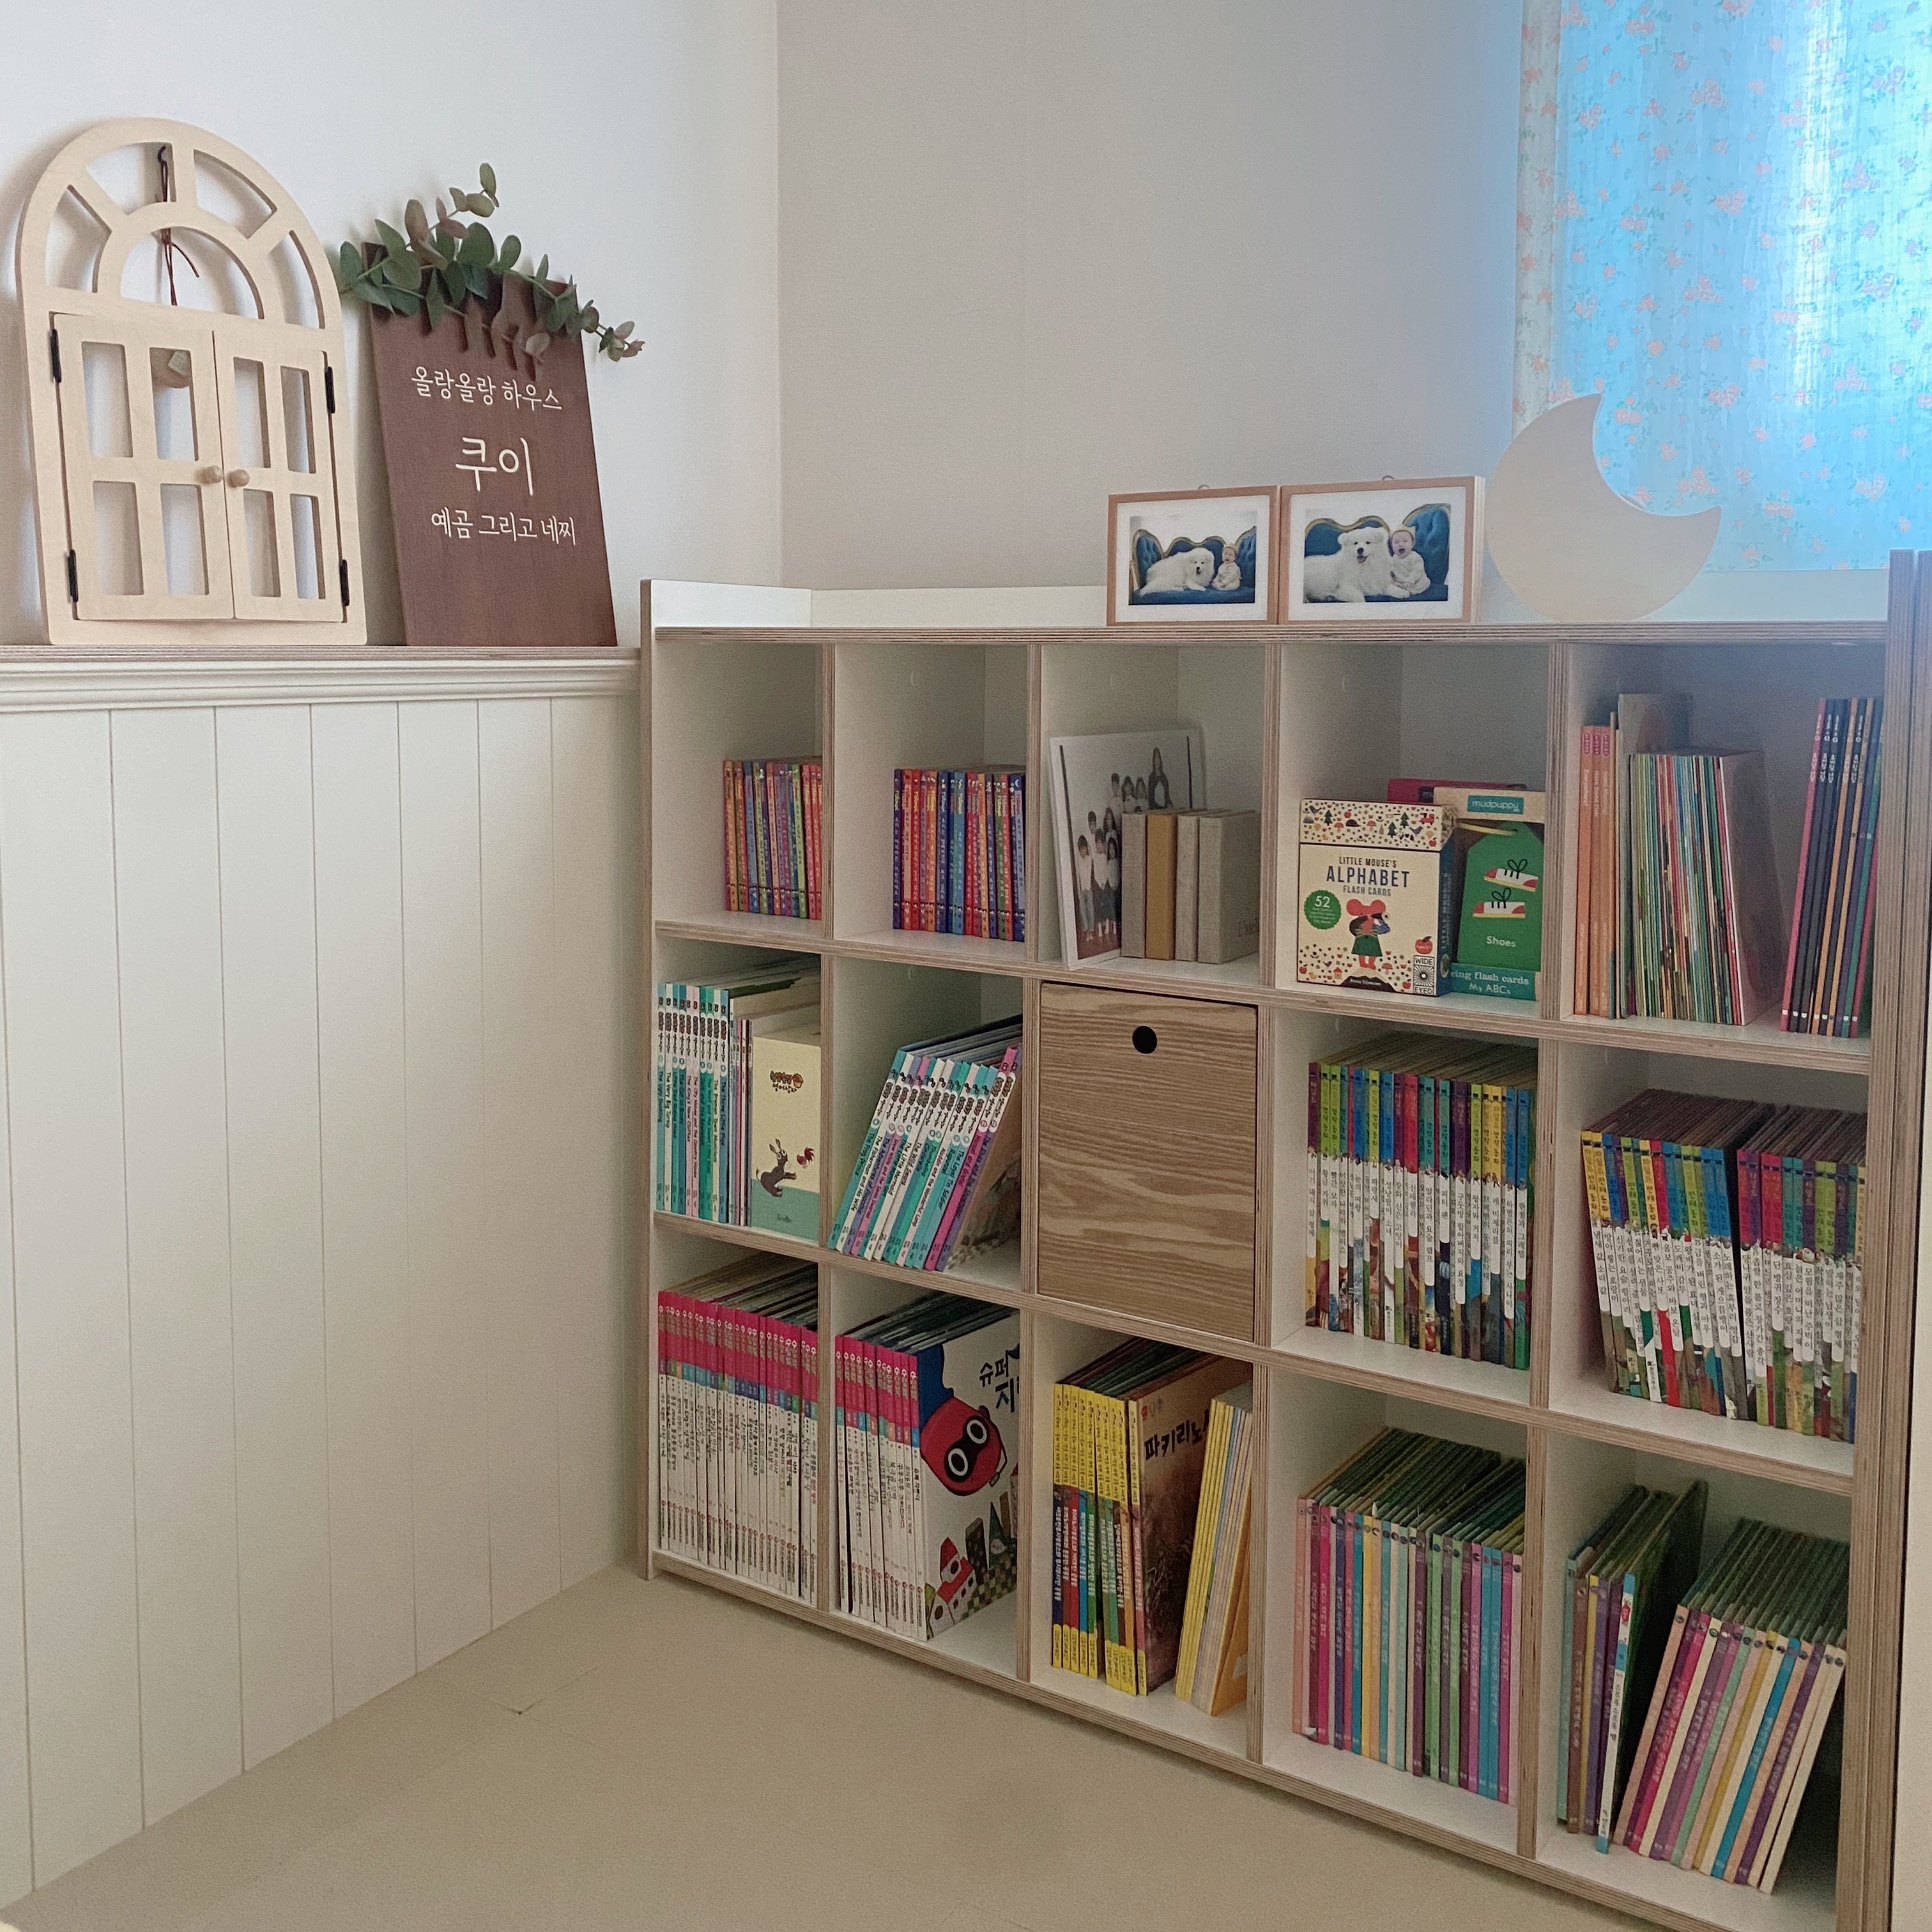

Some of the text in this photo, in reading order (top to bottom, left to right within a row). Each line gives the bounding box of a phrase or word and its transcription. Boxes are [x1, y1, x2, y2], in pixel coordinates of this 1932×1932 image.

[411, 366, 562, 411] 올랑올랑 하우스
[455, 437, 533, 496] 쿠이
[431, 506, 576, 546] 예곰 그리고 네찌
[1472, 800, 1519, 809] mudpuppy
[1339, 856, 1397, 868] LITTLE MOUSE'S
[1326, 866, 1410, 888] ALPHABET
[1343, 885, 1392, 896] FLASH CARDS
[1314, 895, 1330, 907] 52
[1486, 935, 1516, 948] Shoes
[1451, 970, 1529, 985] ring flash cards
[1469, 983, 1511, 995] My ABCs
[898, 1153, 907, 1169] Little
[908, 1153, 917, 1167] Wild
[941, 1148, 956, 1174] Rapunzel
[956, 1149, 965, 1160] The
[859, 1176, 867, 1186] and
[887, 1170, 901, 1195] Mermaid
[1308, 1169, 1315, 1183] 아기
[1395, 1183, 1402, 1198] 장화
[1441, 1191, 1448, 1206] 피터
[849, 1198, 858, 1211] Wife
[1331, 1193, 1337, 1208] 모자
[1395, 1202, 1402, 1219] 신은
[1426, 1226, 1432, 1242] 요술
[1473, 1225, 1479, 1242] 거지
[1713, 1252, 1721, 1269] 소가
[1457, 1271, 1464, 1287] 요정
[1666, 1266, 1675, 1292] 공주와
[1669, 1298, 1678, 1314] 바보
[1774, 1296, 1781, 1314] 장수
[979, 1350, 1009, 1387] 슈퍼
[995, 1376, 1020, 1413] 지
